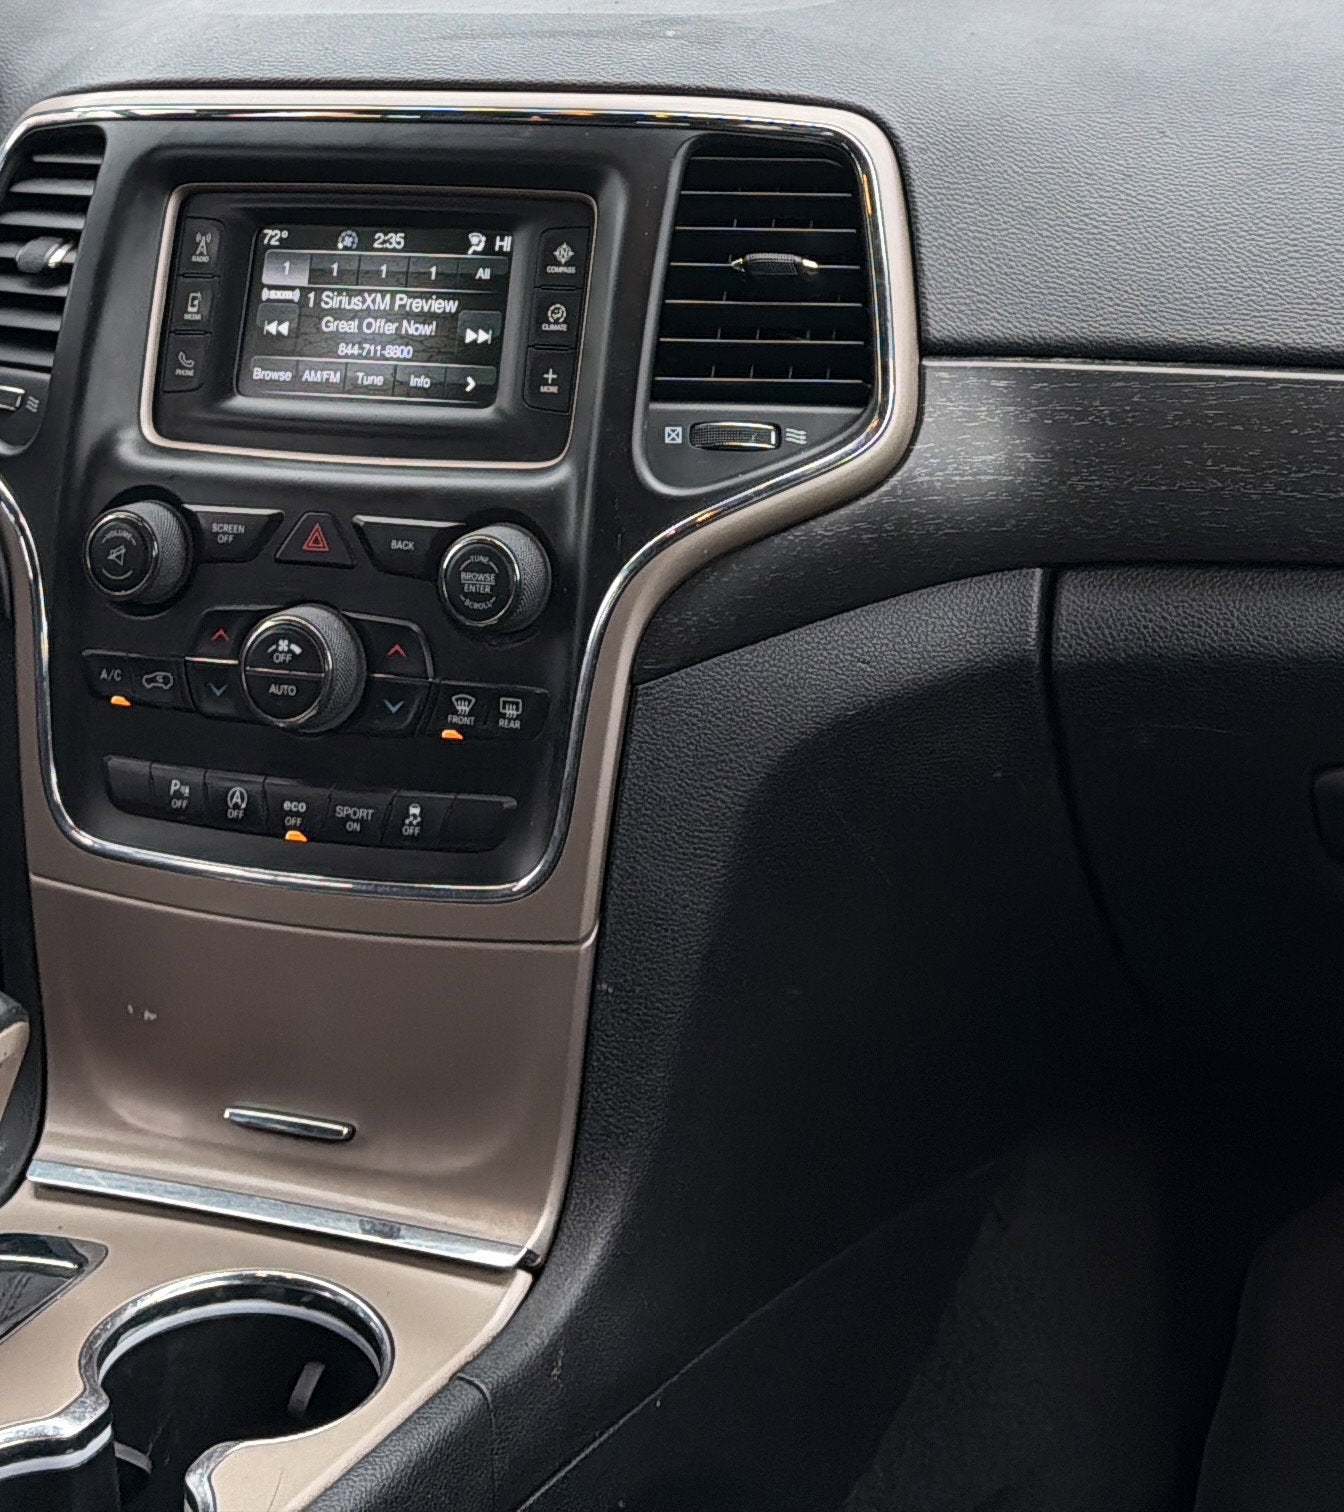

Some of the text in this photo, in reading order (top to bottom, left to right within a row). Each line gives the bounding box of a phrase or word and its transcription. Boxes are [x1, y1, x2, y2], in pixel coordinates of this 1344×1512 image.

[373, 232, 405, 249] 2:35
[495, 235, 512, 252] HI
[283, 261, 291, 276] 1
[331, 262, 339, 277] 1
[380, 264, 387, 278] 1
[429, 266, 437, 280] 1
[475, 268, 491, 280] All
[308, 291, 459, 314] 1 SiriusXM Preview
[321, 315, 436, 336] Great Offer Now!
[253, 368, 293, 383] Browse
[302, 369, 341, 384] AM/FM
[357, 372, 384, 386] Tune
[410, 374, 431, 389] Info
[211, 522, 245, 534] SCREEN
[217, 534, 235, 544] OFF
[391, 539, 415, 551] BACK
[460, 571, 495, 582] BROWSE
[464, 583, 491, 594] ENTER
[273, 653, 292, 664] OFF
[99, 669, 122, 681] A/C
[269, 684, 296, 696] AUTO
[447, 714, 475, 726] FRONT
[498, 718, 520, 729] REAR
[171, 798, 187, 810] OFF
[283, 801, 306, 812] eco
[227, 809, 244, 820] OFF
[336, 806, 374, 821] SPORT
[285, 815, 302, 827] OFF
[346, 821, 361, 833] ON
[402, 825, 420, 837] OFF
